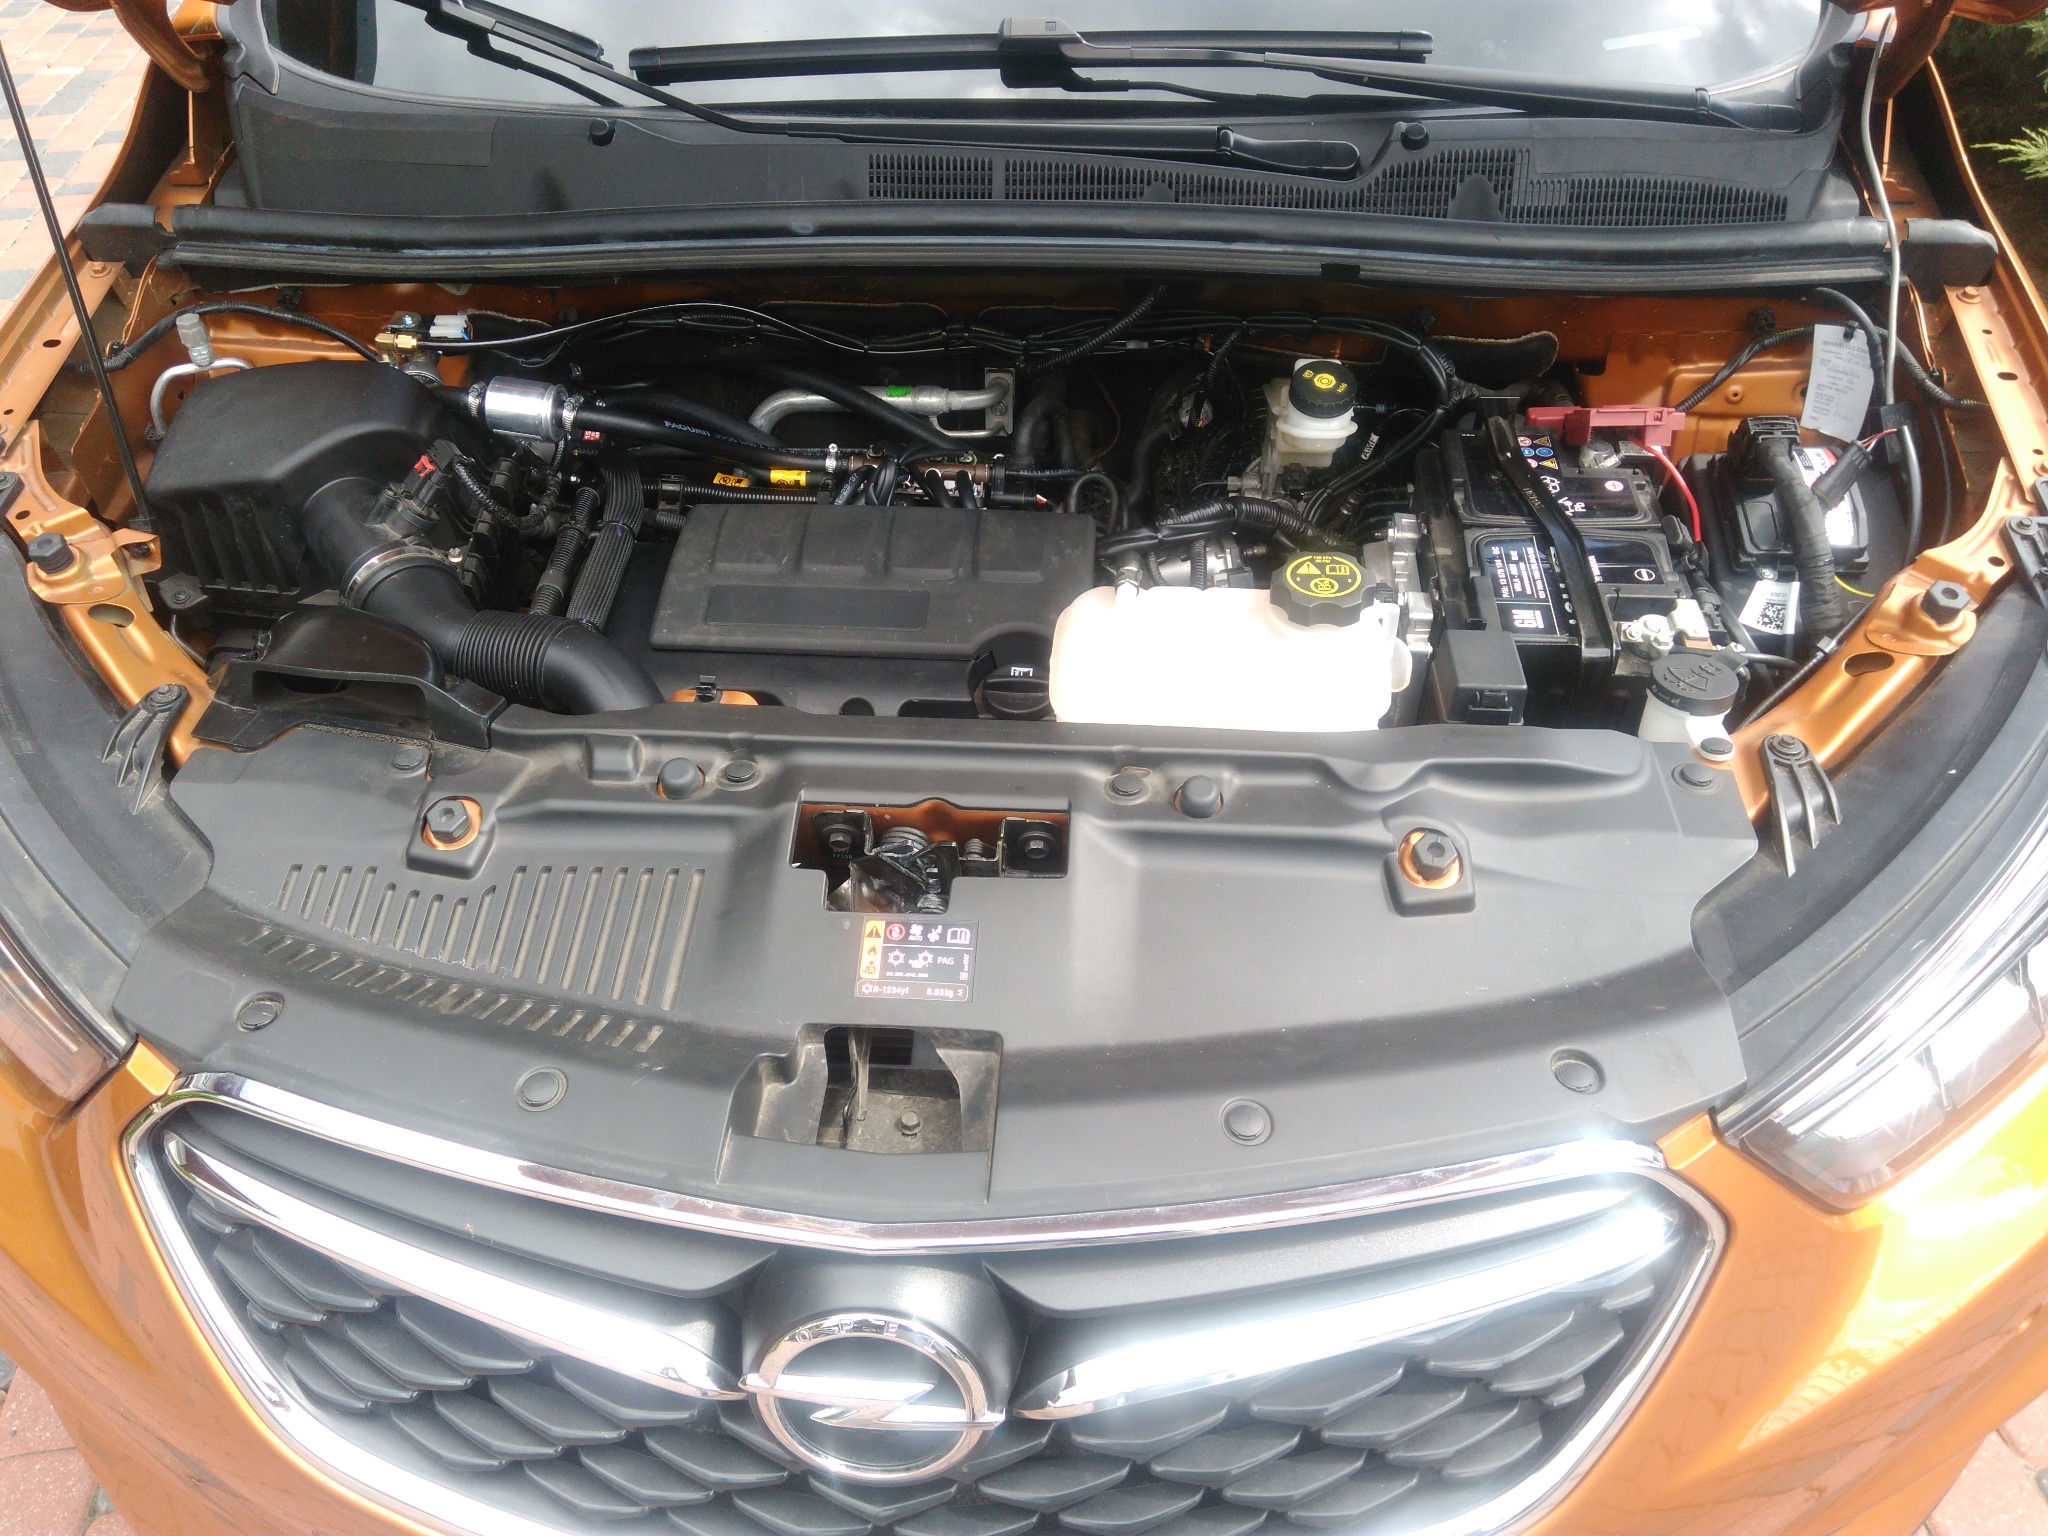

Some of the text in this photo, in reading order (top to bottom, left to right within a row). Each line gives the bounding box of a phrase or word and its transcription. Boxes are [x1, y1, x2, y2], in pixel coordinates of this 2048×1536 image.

[1511, 609, 1538, 628] GM
[937, 956, 955, 966] PAG
[873, 985, 910, 995] R-1234yf
